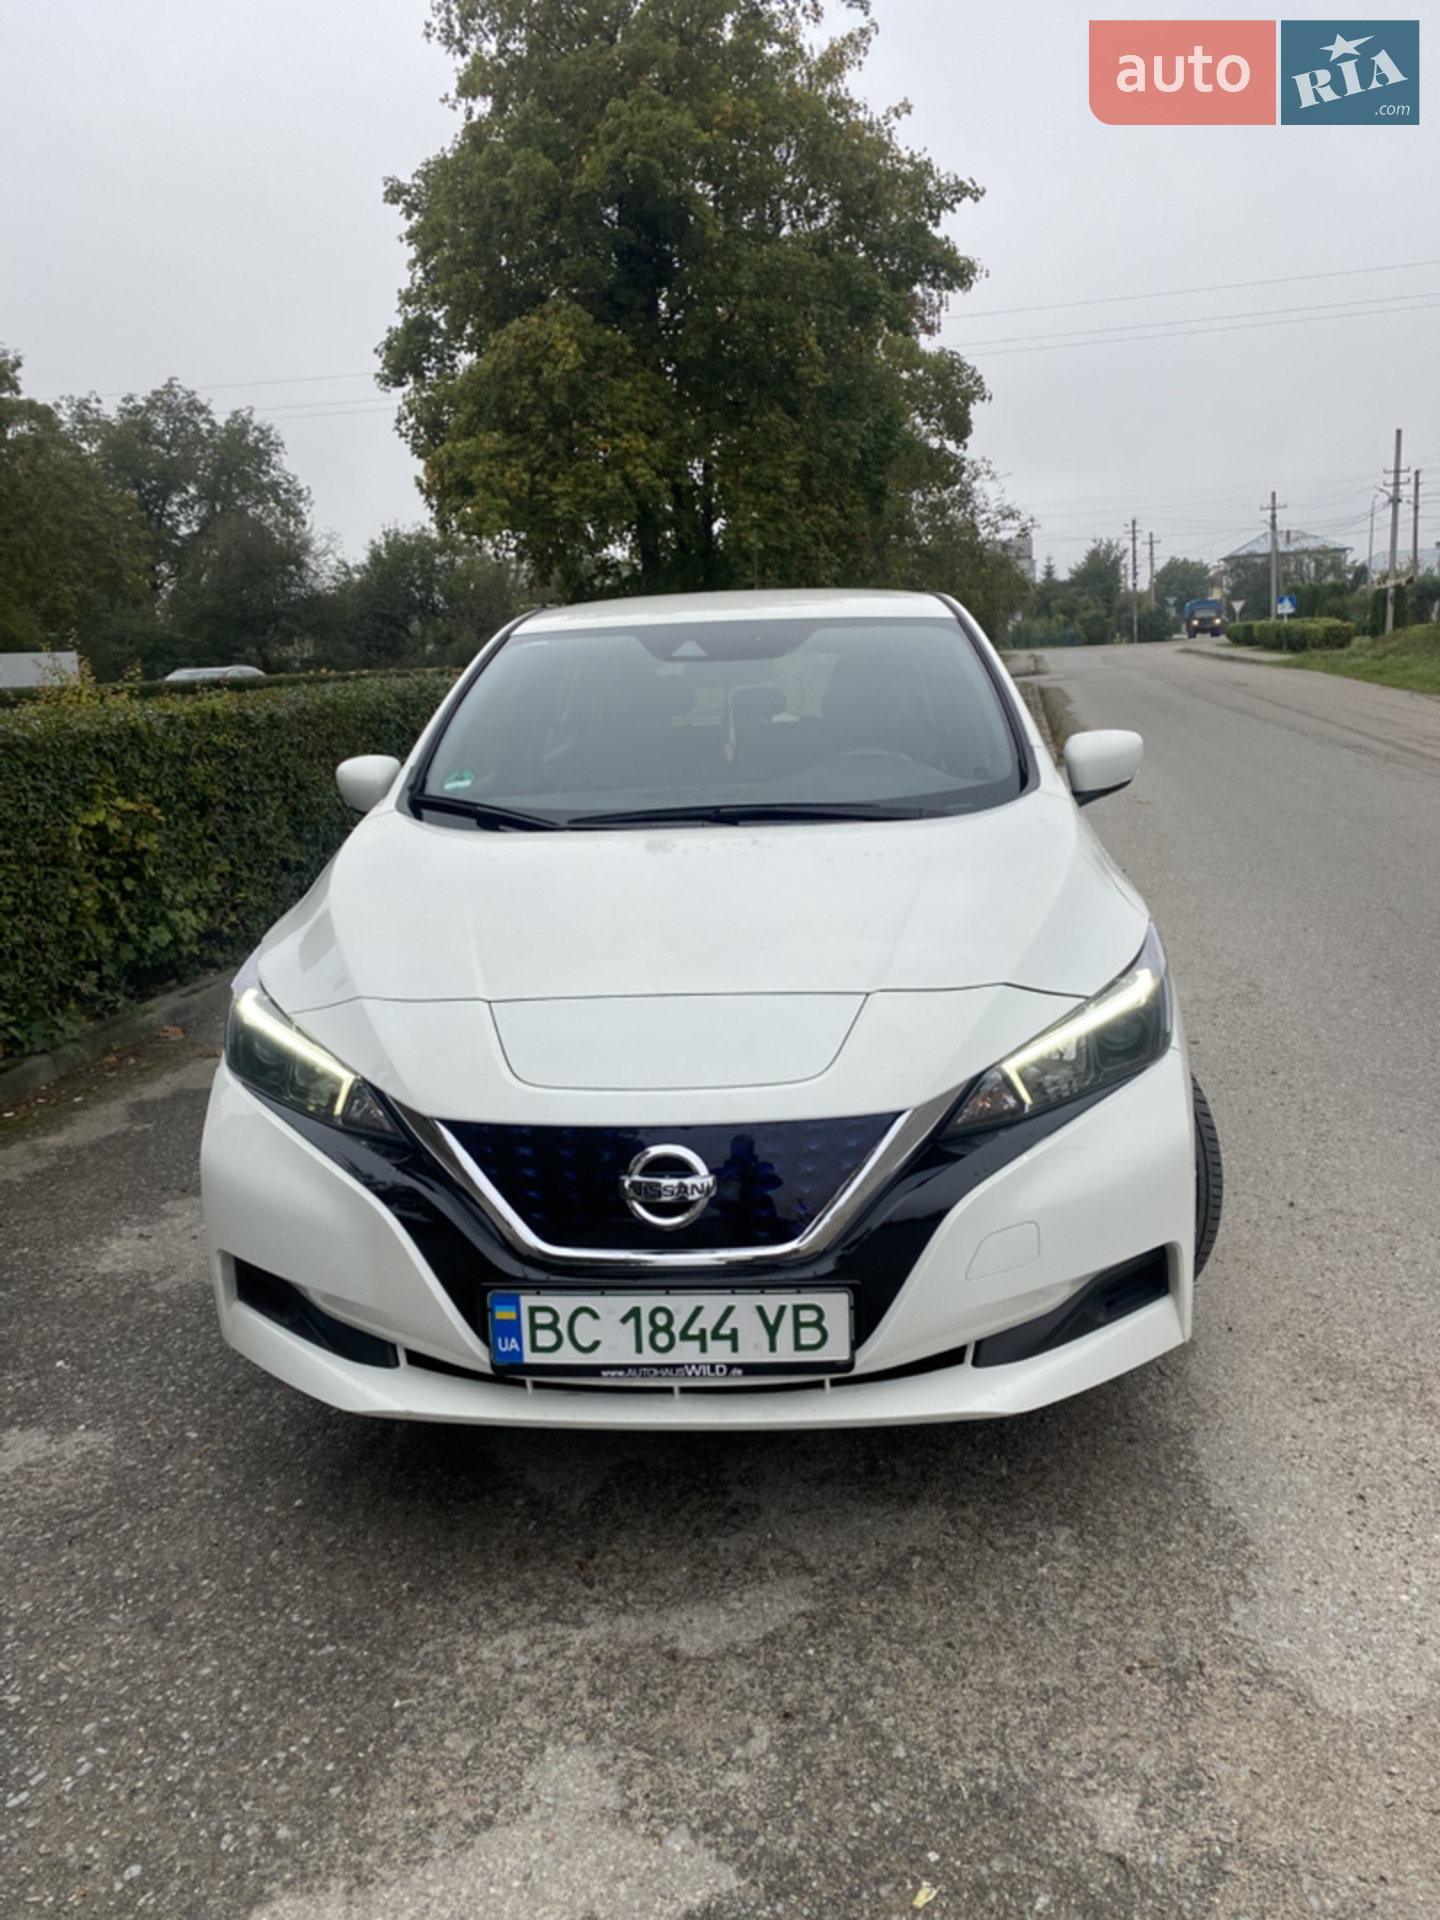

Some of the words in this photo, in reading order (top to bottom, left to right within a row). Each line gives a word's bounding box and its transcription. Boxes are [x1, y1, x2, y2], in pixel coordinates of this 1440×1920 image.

[629, 1181, 705, 1198] NISSAN
[527, 1304, 602, 1354] BC
[619, 1304, 739, 1354] 1844
[755, 1302, 829, 1353] YB
[498, 1337, 520, 1353] UA
